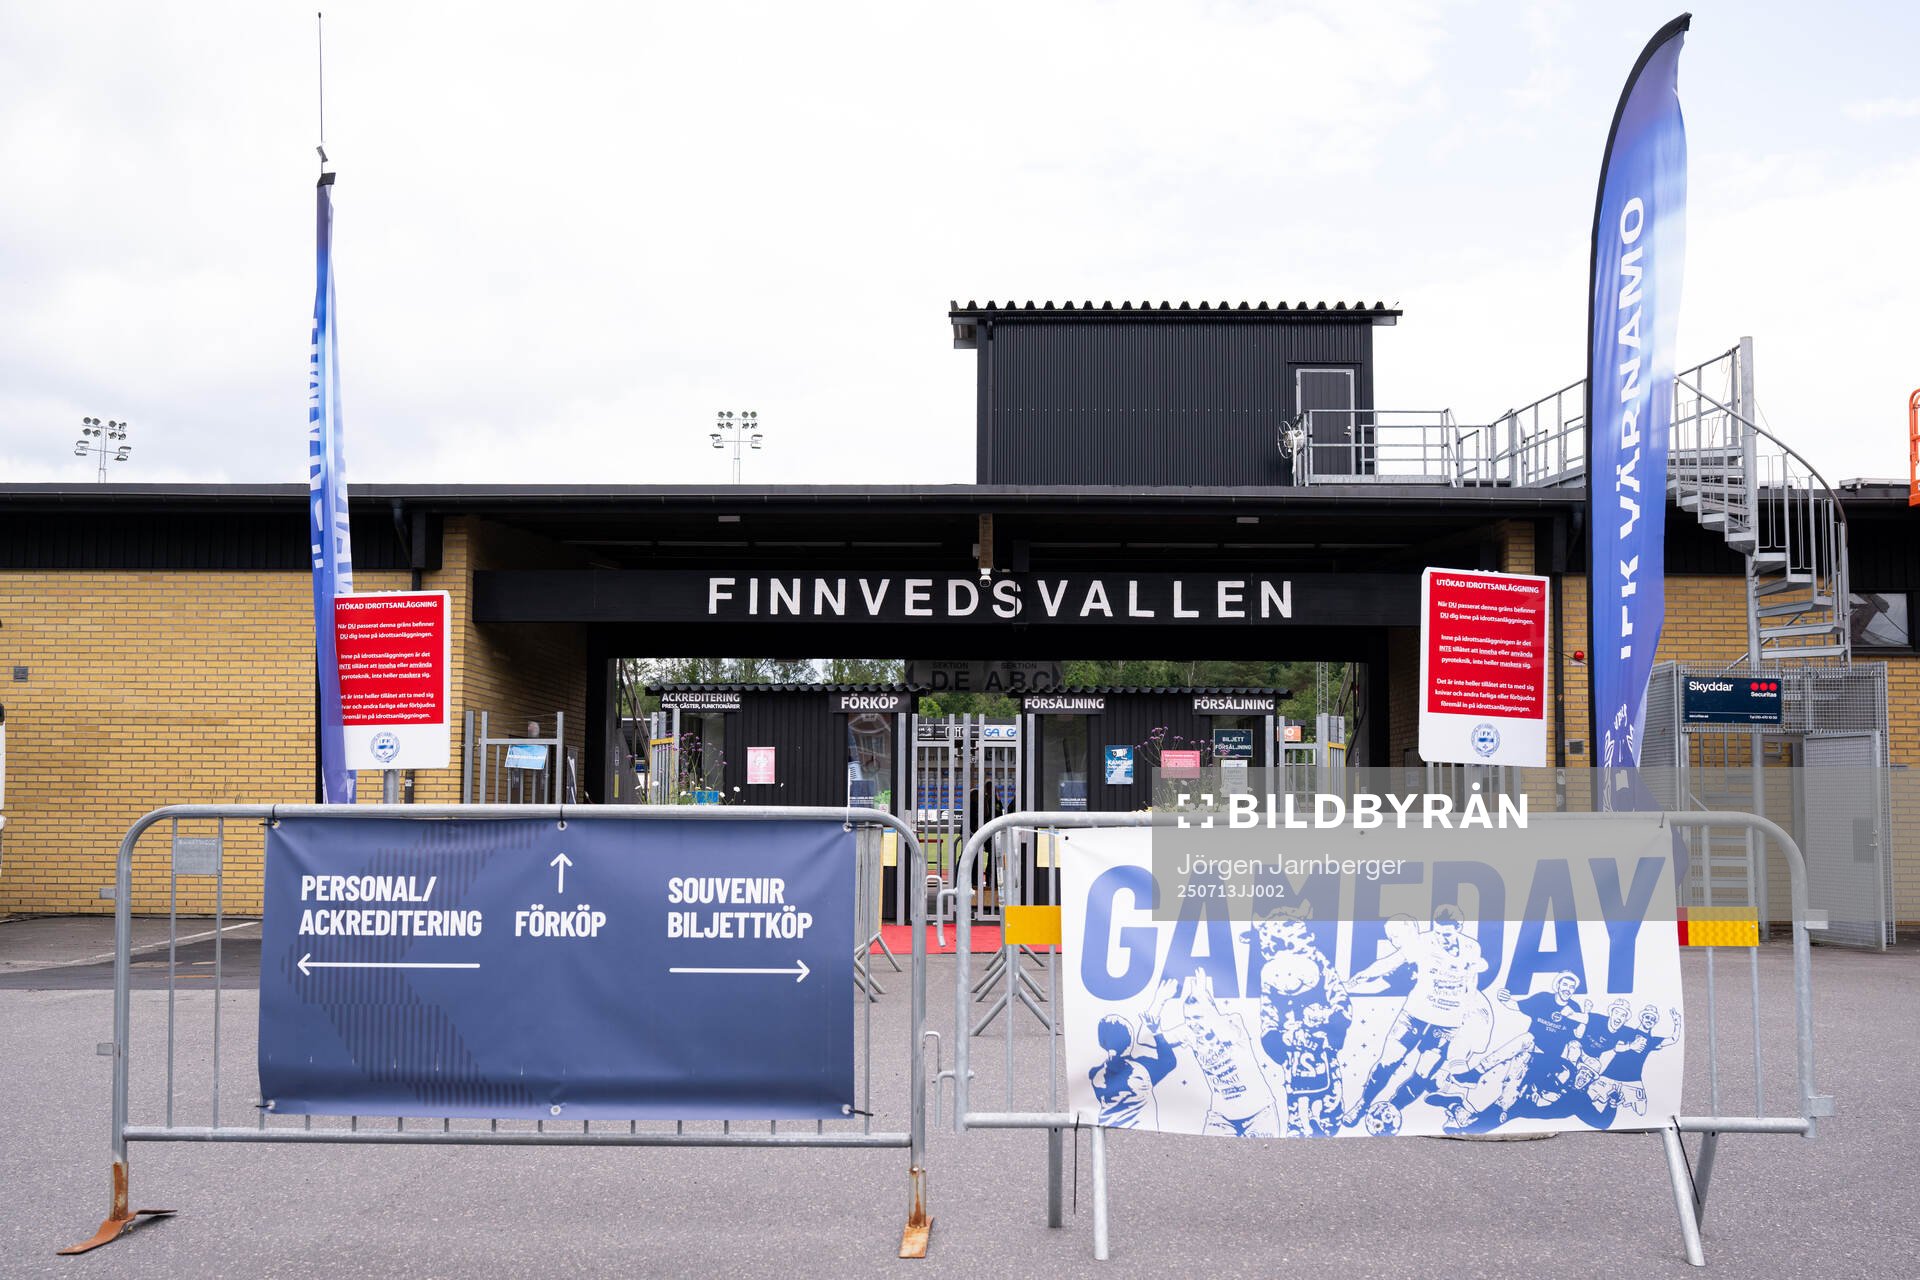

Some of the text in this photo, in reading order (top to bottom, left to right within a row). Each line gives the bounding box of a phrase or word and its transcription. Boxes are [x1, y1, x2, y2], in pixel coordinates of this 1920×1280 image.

[1616, 197, 1644, 540] VÄRNAMO
[1436, 579, 1539, 593] UTÖKAD IDROTTSANLÄGGNING
[365, 601, 437, 609] IDROTTSANLÄGGNING
[708, 578, 1293, 619] FINNVEDSVALLEN
[1480, 616, 1534, 625] idrottsanläggningen.
[1462, 636, 1515, 645] idrottsanläggningen
[1689, 681, 1734, 693] Skyddar
[662, 693, 740, 702] ACKREDITERING
[841, 694, 899, 710] FÖRKÖP
[1024, 696, 1104, 710] FÖRSÄLJNING
[1194, 696, 1274, 710] FÖRSÄLJNING
[680, 702, 700, 710] GÄSTER,
[1477, 703, 1530, 712] idrottsanläggningen.
[301, 875, 436, 902] PERSONAL/
[668, 877, 786, 904] SOUVENIR
[299, 909, 482, 937] ACKREDITERING
[515, 904, 607, 937] FÖRKÖP
[668, 905, 813, 938] BILJETTKÖP
[1080, 856, 1666, 1001] GAMEDAY
